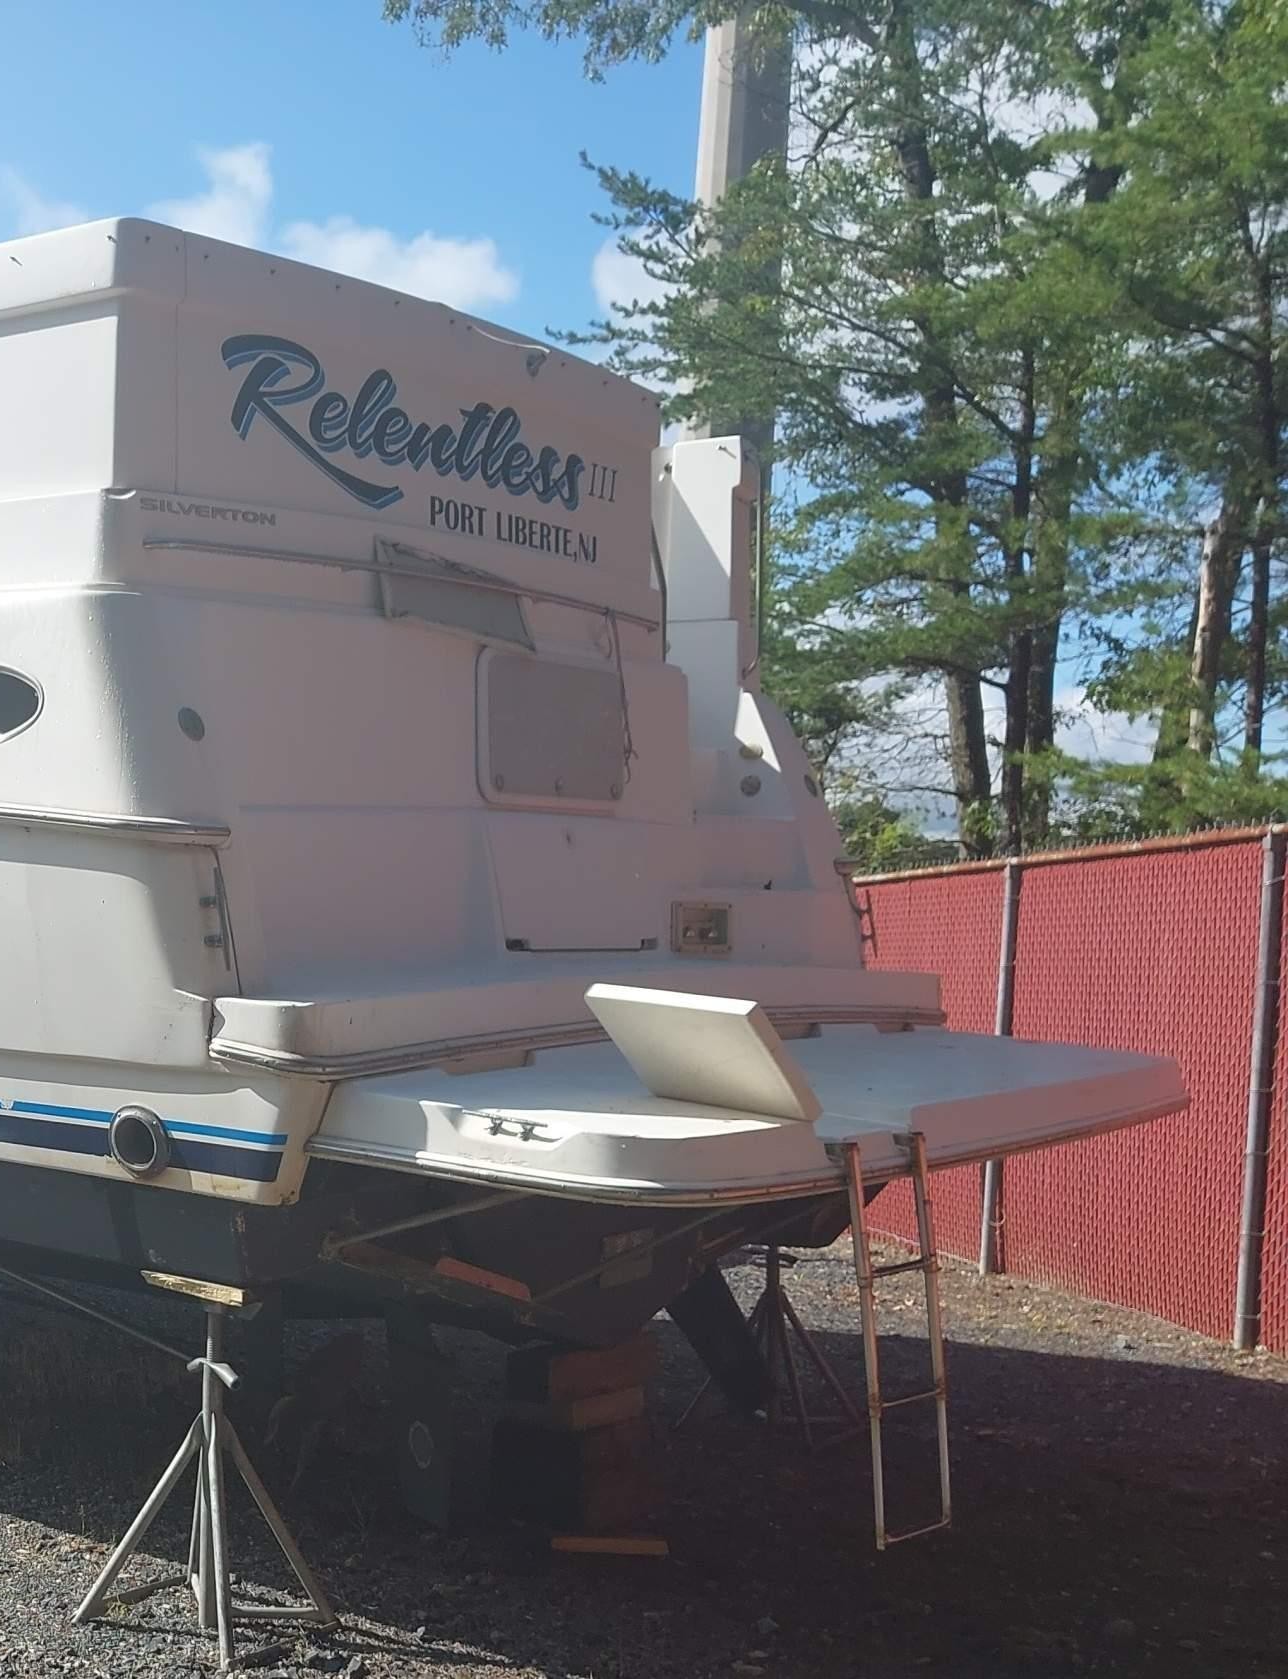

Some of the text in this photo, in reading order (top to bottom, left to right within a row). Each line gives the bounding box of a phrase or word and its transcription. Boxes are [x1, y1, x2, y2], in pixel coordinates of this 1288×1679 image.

[221, 334, 618, 510] Relentless III
[139, 497, 277, 526] SILVERTON
[430, 496, 487, 536] PORT
